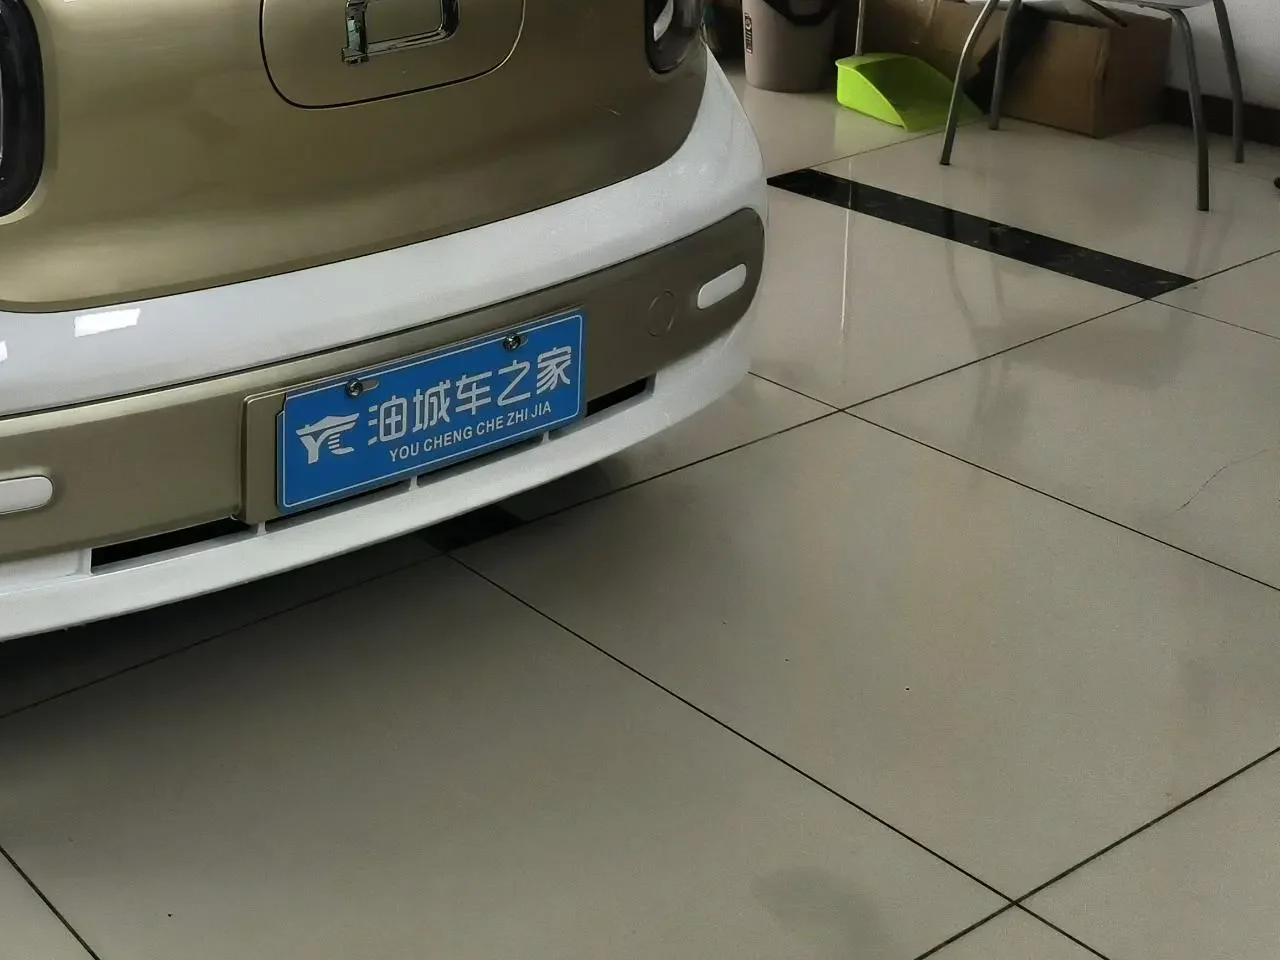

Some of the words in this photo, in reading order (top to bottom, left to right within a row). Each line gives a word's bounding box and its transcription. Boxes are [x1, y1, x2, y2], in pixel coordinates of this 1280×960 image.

[368, 346, 572, 446] 油城车之家
[389, 441, 420, 462] YOU
[423, 421, 473, 453] CHENG
[476, 414, 504, 437] CHE
[507, 407, 529, 426] ZHI
[531, 400, 552, 420] JIA
